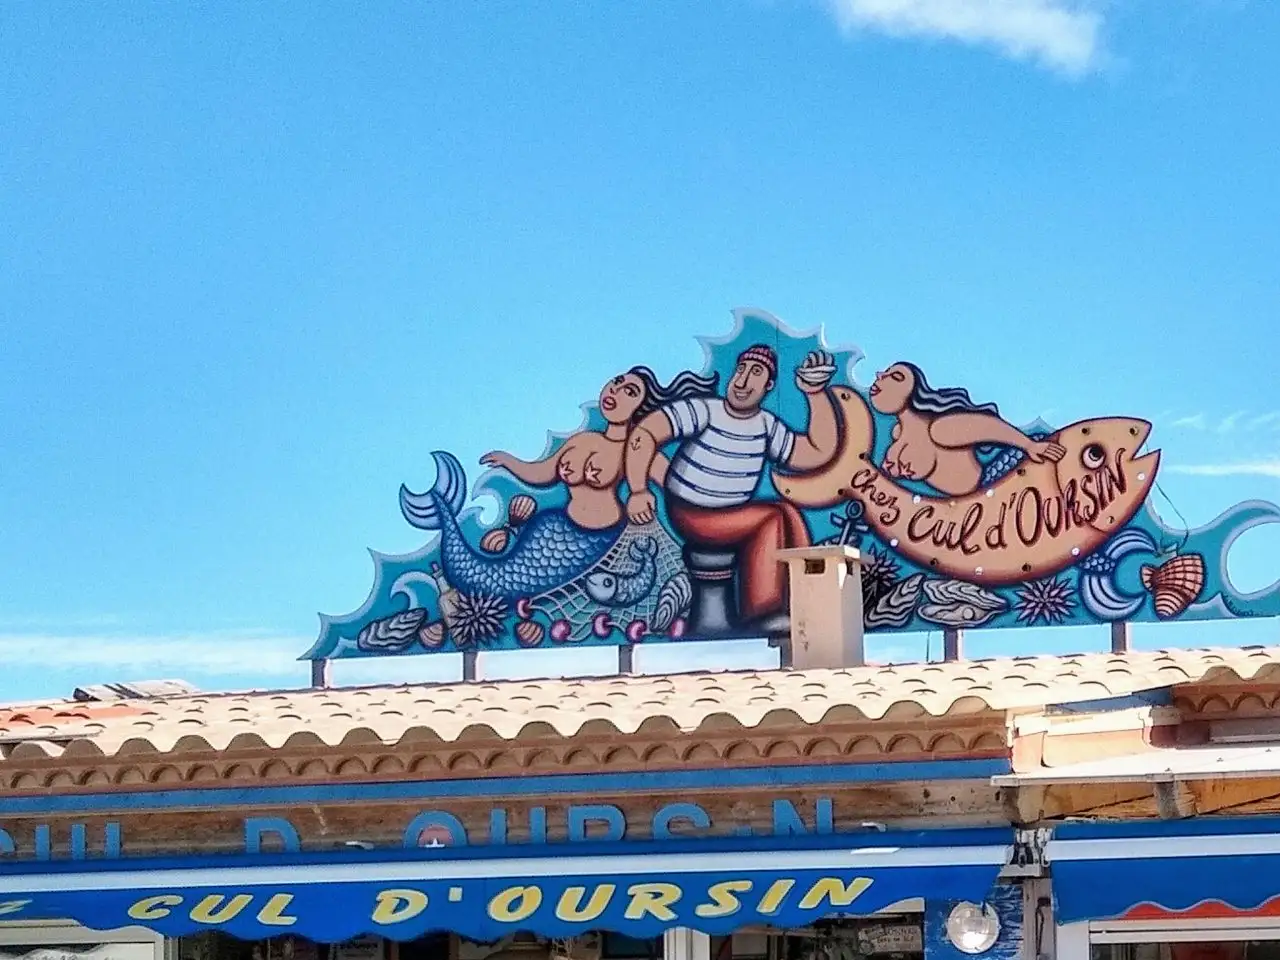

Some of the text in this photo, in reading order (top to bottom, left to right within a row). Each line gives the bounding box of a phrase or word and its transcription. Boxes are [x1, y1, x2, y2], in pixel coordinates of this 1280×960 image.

[907, 501, 983, 556] Cul
[127, 876, 875, 926] CUL D'OURSIN
